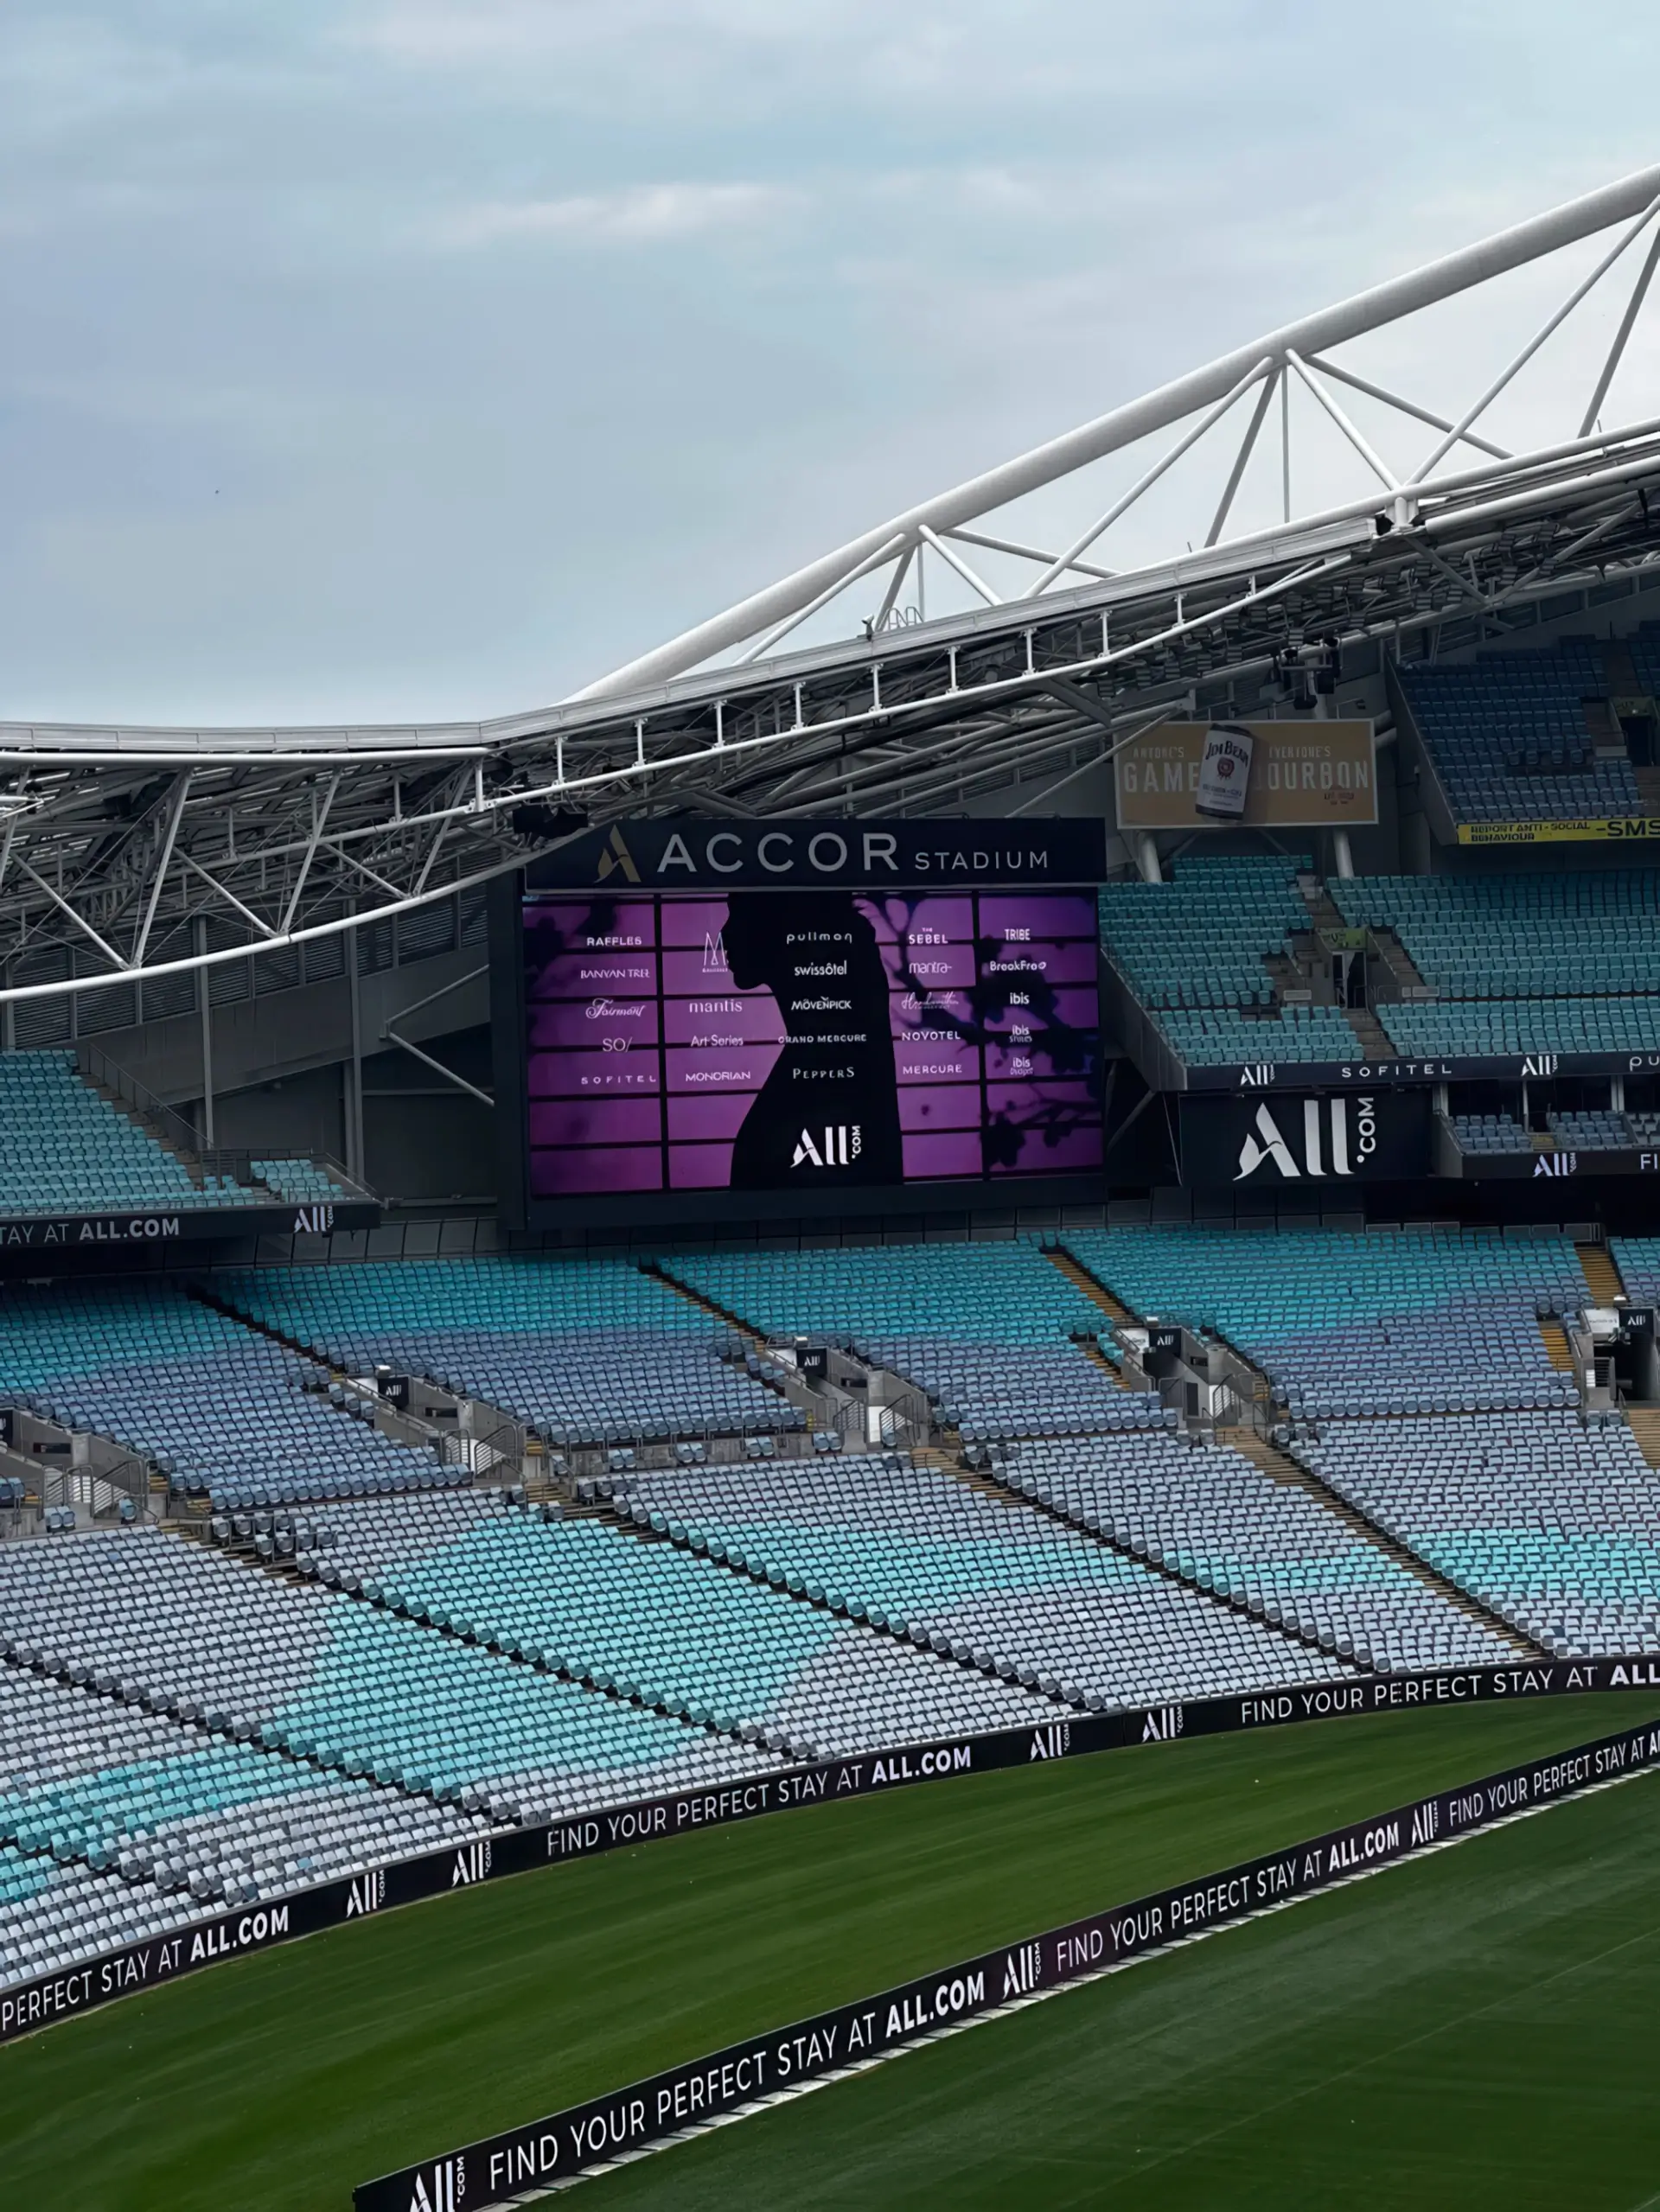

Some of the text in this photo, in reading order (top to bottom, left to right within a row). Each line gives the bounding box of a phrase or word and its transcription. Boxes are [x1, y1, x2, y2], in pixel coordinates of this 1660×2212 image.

[1124, 762, 1200, 793] GAME
[1550, 821, 1591, 831] SOCIAL
[657, 832, 1048, 874] ACCOR STADIUM
[586, 936, 642, 947] RAFFLES
[909, 934, 948, 945] SEBEL
[1004, 928, 1031, 941] TRIBE
[1010, 991, 1030, 1005] ibis
[689, 998, 744, 1014] mantis
[902, 1031, 961, 1042] NOVOTEL
[1012, 1024, 1030, 1036] ibis
[711, 1034, 744, 1047] Series
[1012, 1056, 1031, 1068] ibis
[903, 1064, 963, 1075] MERCURE
[1342, 1063, 1452, 1078] SOFITEL
[580, 1074, 657, 1085] SOFITEL
[44, 1222, 70, 1244] AT
[79, 1217, 180, 1241] ALL.COM
[1242, 1696, 1293, 1724] FIND
[1301, 1688, 1364, 1714] YOUR
[1375, 1674, 1483, 1705] PERFECT
[1493, 1668, 1554, 1693] STAY
[1566, 1666, 1597, 1688] AT
[1449, 1792, 1484, 1827] FIND
[1487, 1776, 1529, 1812] YOUR
[1533, 1755, 1591, 1797] PERFECT
[1595, 1742, 1627, 1775] STAY
[1631, 1736, 1645, 1764] AT
[547, 1745, 971, 1857] FIND YOUR PERFECT STAY AT ALL.COM
[1057, 1821, 1400, 1973] FIND YOUR PERFECT STAY AT ALL.COM
[2, 1905, 289, 2031] PERFECT STAY AT ALL.COM
[489, 1971, 985, 2190] FIND YOUR PERFECT STAY AT ALL.COM
